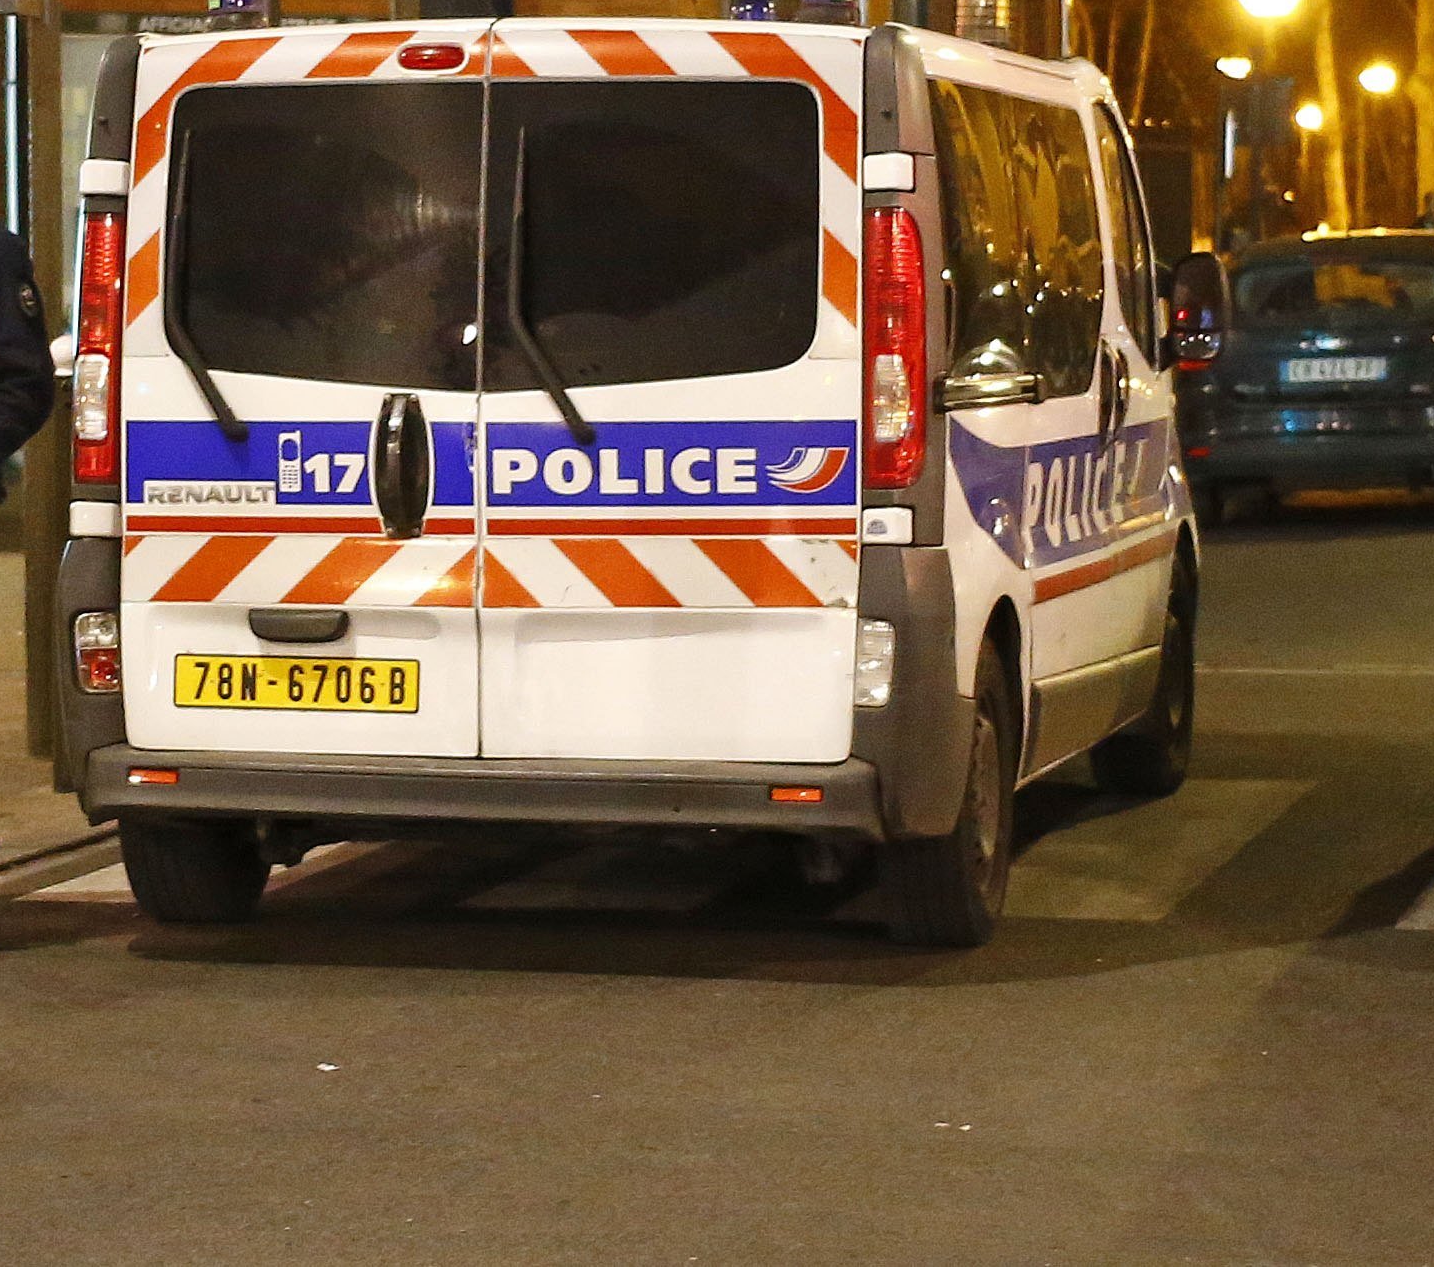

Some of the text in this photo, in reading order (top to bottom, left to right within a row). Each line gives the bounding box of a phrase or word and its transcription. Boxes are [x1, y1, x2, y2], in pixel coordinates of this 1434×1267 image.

[303, 453, 366, 493] 17
[492, 447, 757, 495] POLICE
[146, 485, 276, 504] RENAULT
[1020, 439, 1127, 554] POLICE
